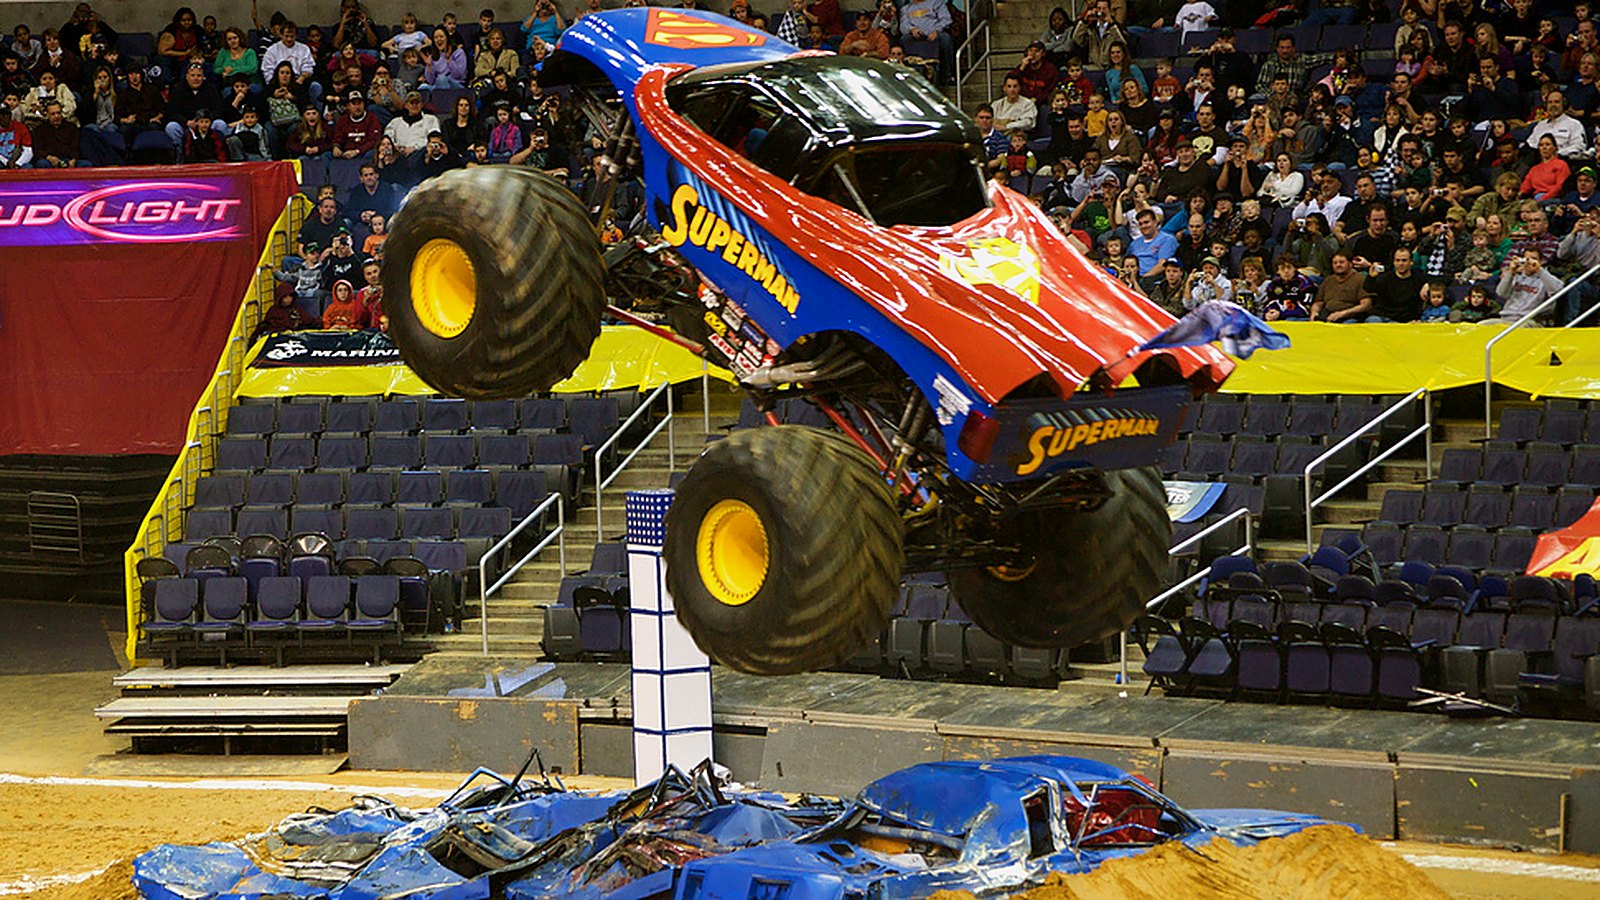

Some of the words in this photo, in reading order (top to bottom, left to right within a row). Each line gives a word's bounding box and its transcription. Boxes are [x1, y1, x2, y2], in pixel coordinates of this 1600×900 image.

[89, 199, 241, 224] LIGHT
[662, 184, 800, 314] SUPERMAN
[1016, 418, 1159, 475] SUPERMAN
